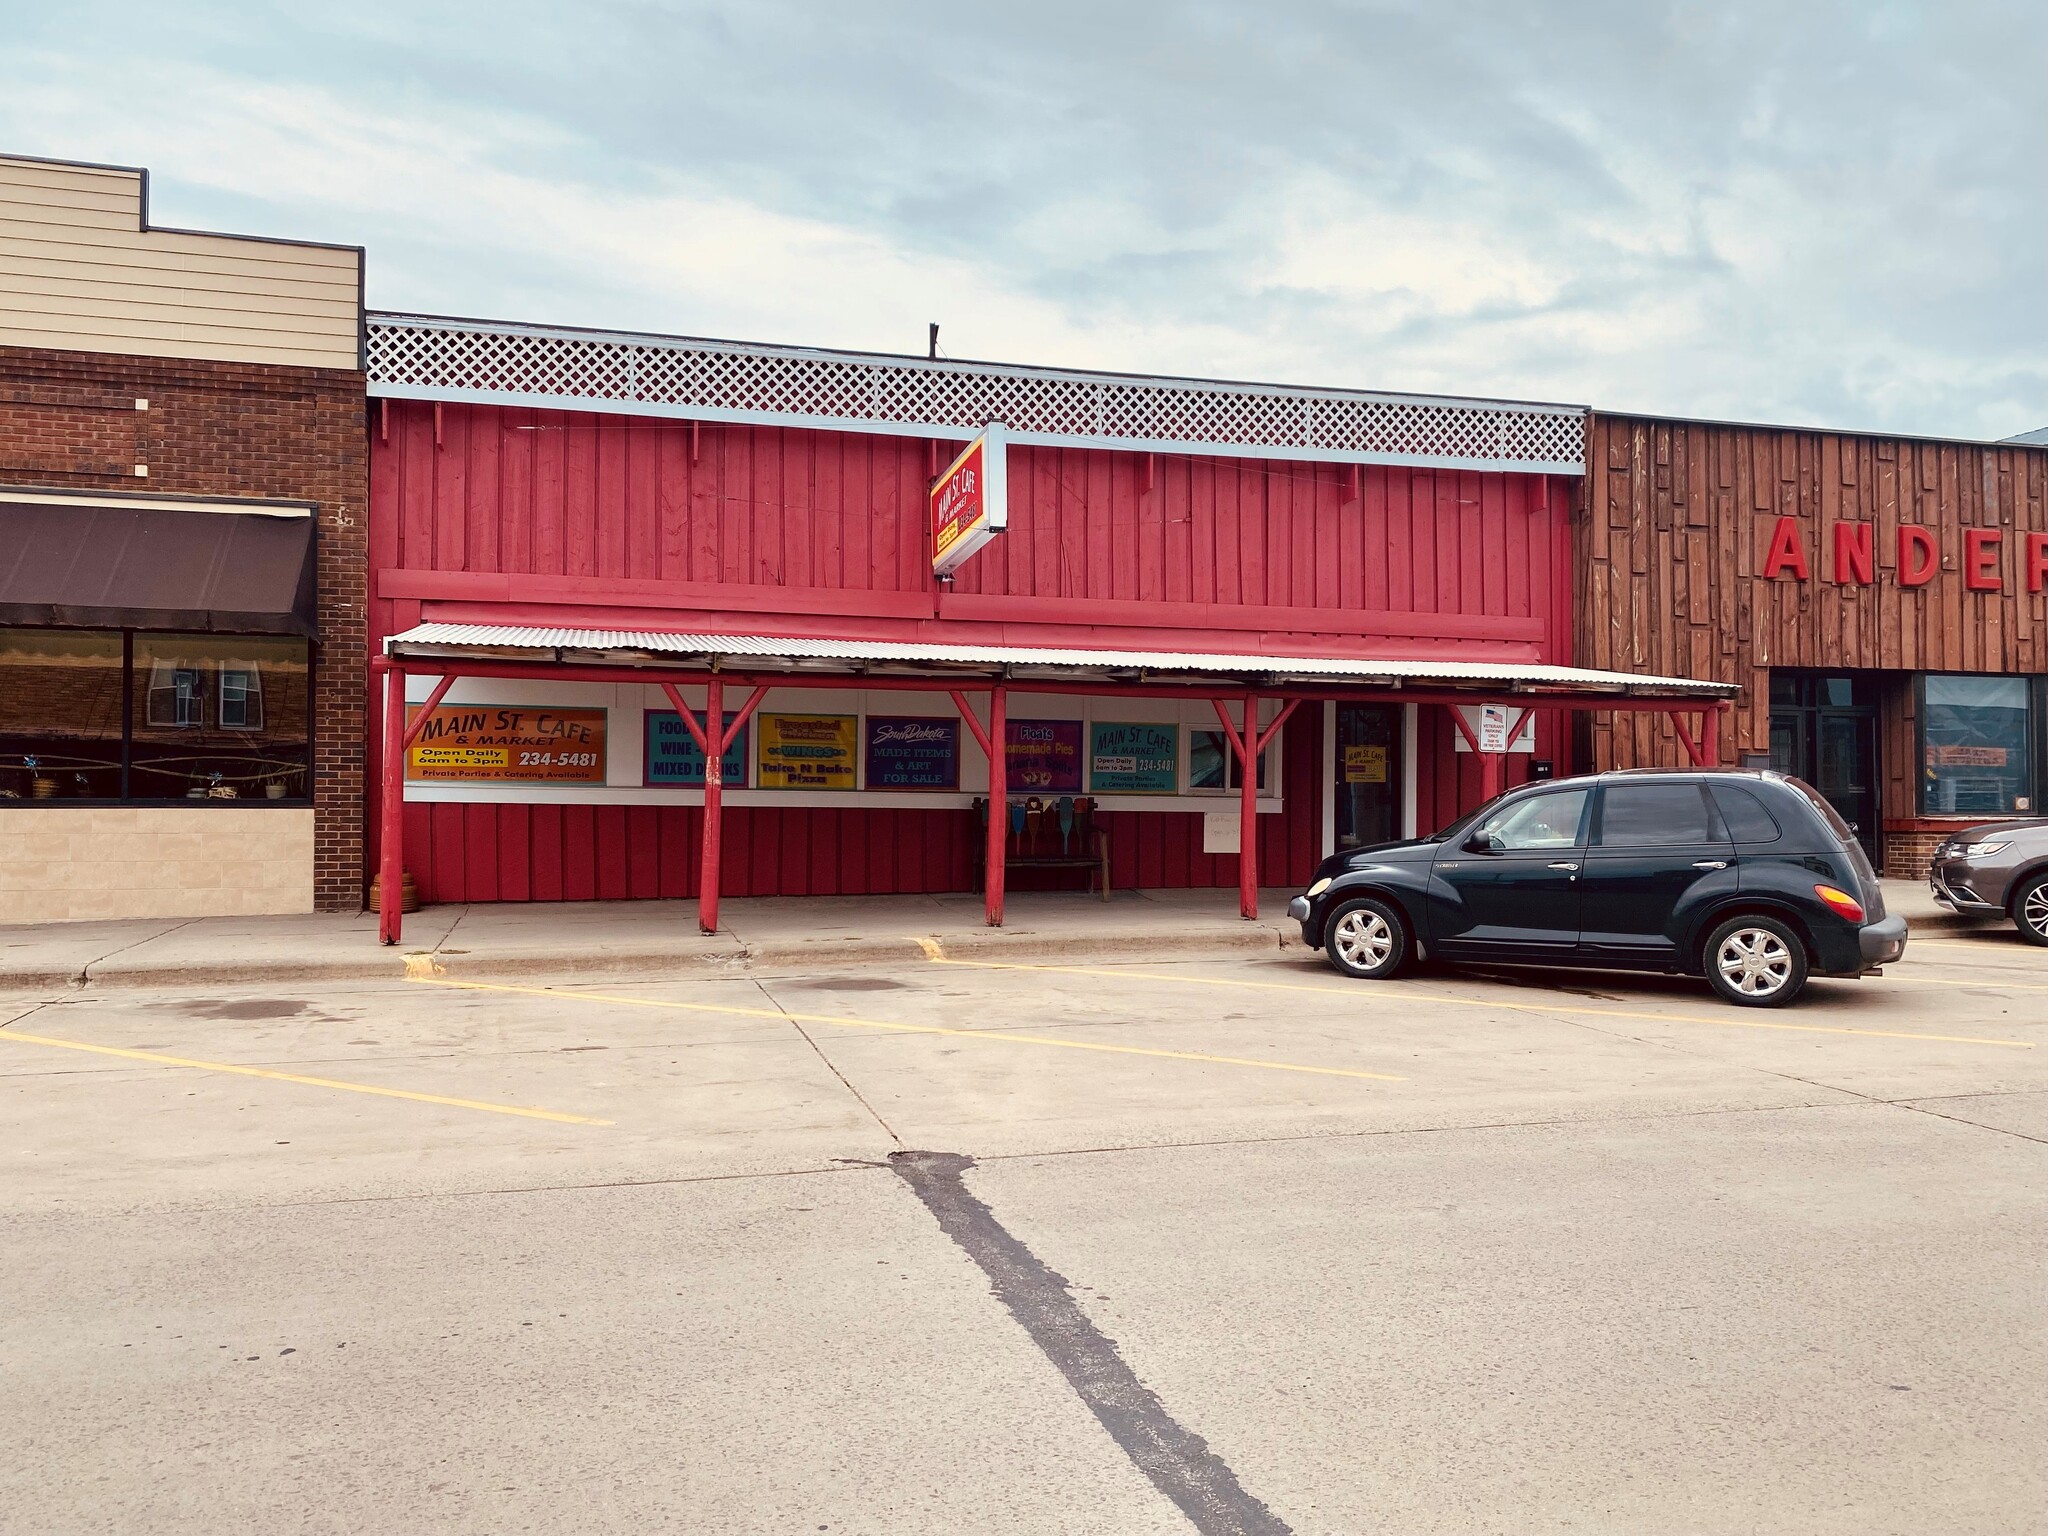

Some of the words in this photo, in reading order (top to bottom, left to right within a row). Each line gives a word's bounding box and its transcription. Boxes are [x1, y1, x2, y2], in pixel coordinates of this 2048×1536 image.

[962, 468, 975, 494] CAFE
[420, 713, 486, 742] MAIN
[495, 710, 524, 731] ST.
[537, 714, 592, 744] CAFE
[659, 721, 690, 734] FOOD
[1021, 726, 1054, 740] Floats
[455, 736, 469, 744] &
[476, 736, 558, 746] MARKET
[1097, 728, 1126, 753] MAIN
[1128, 726, 1142, 743] ST.
[1147, 730, 1172, 753] CAFE
[466, 750, 501, 758] Daily
[660, 742, 691, 755] WINE
[781, 745, 834, 758] WINGS
[874, 748, 910, 758] MADE
[912, 749, 952, 758] ITEMS
[1055, 742, 1074, 755] Pies
[519, 752, 597, 767] 234-5481
[895, 762, 904, 770] &
[907, 762, 931, 770] ART
[1139, 759, 1174, 771] 234-5481
[504, 771, 544, 779] Catering
[654, 762, 692, 775] MIXED
[696, 763, 739, 776] DKS
[762, 763, 795, 773] Take
[800, 764, 812, 773] N
[816, 764, 853, 774] Bake
[788, 774, 827, 783] Pizza
[884, 774, 909, 782] FOR
[912, 774, 942, 783] SALE
